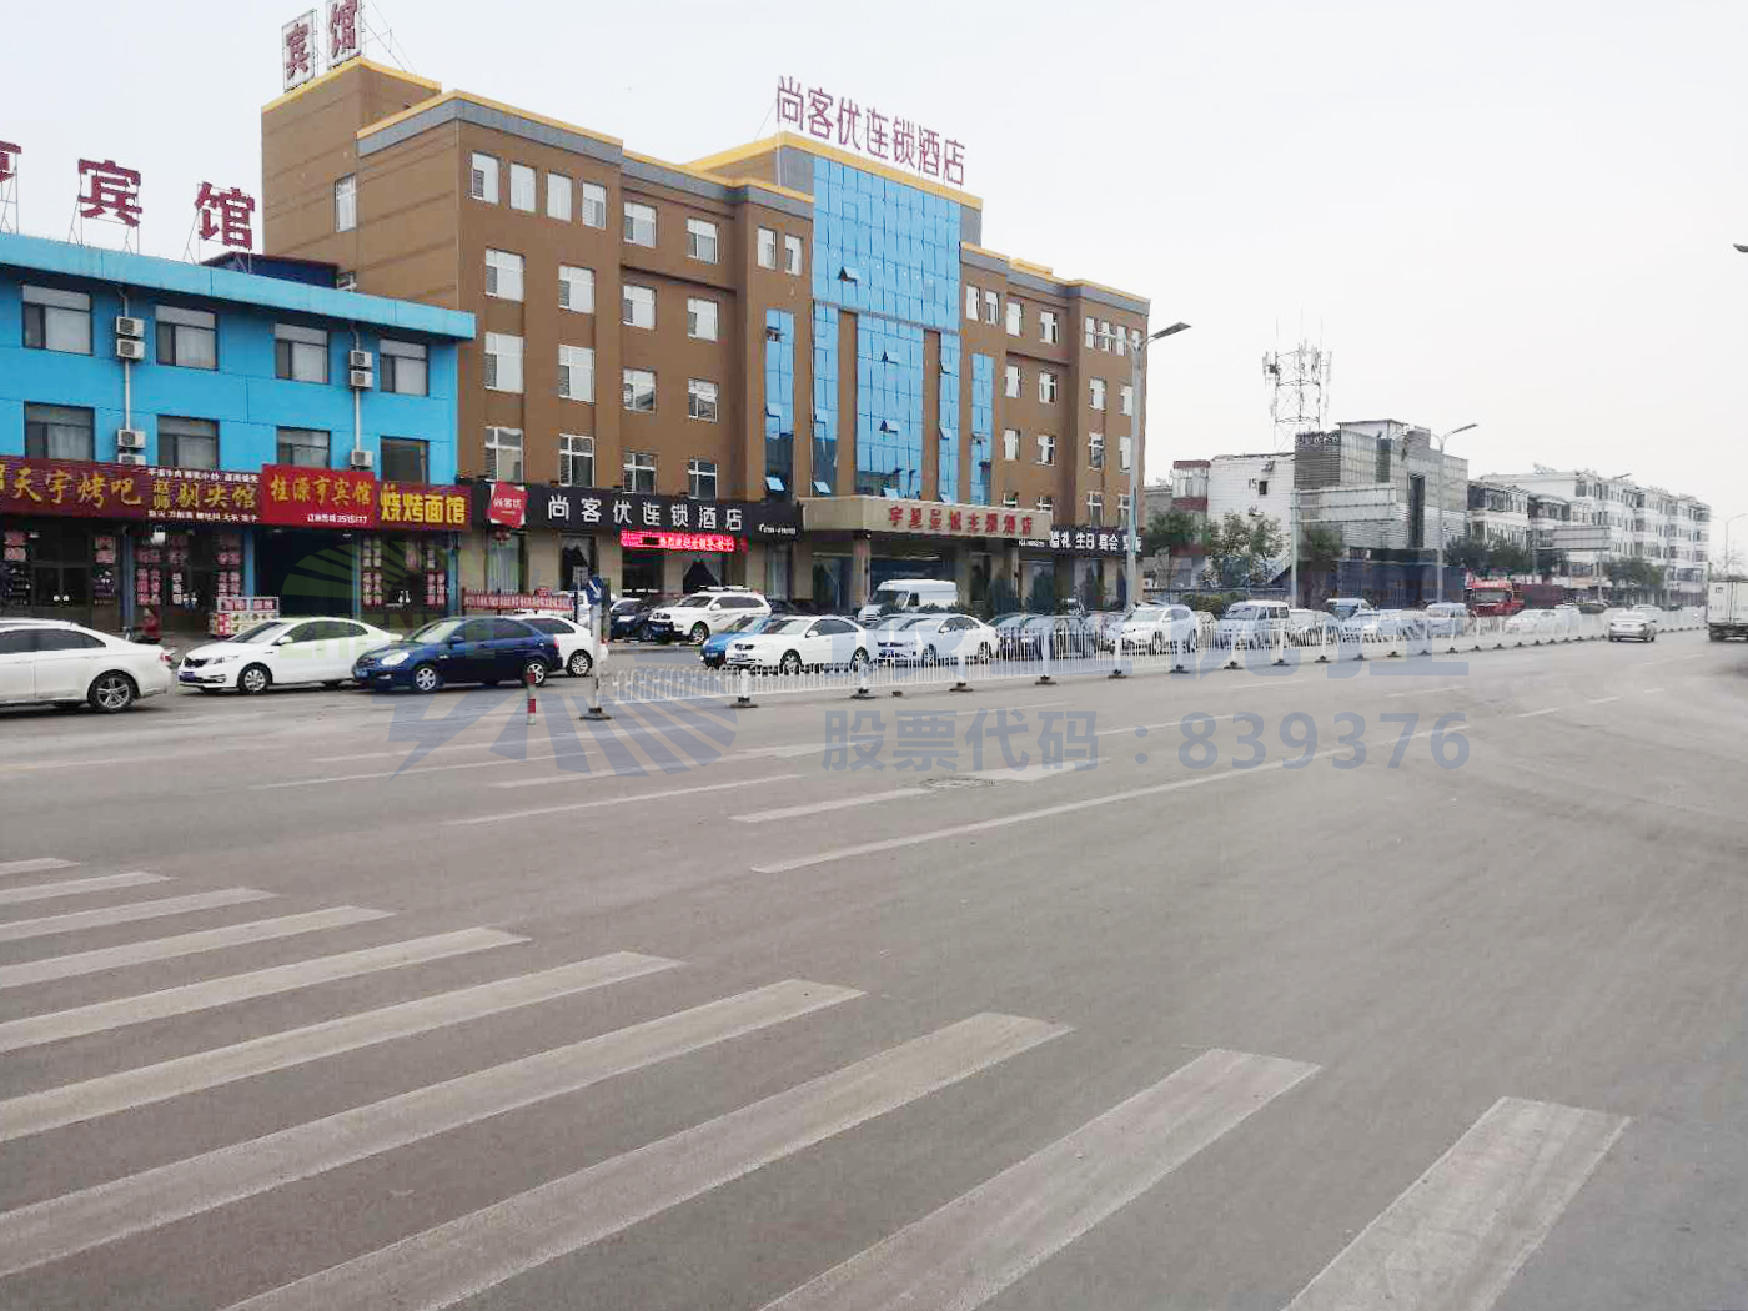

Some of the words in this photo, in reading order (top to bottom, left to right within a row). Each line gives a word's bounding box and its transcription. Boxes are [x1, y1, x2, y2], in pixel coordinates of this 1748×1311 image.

[285, 0, 358, 79] 宾馆
[777, 75, 965, 186] 尚客优连锁酒店
[0, 461, 142, 509] 天宇烤吧
[380, 481, 465, 524] 烧烤面馆
[547, 493, 743, 532] 尚客优连锁酒店
